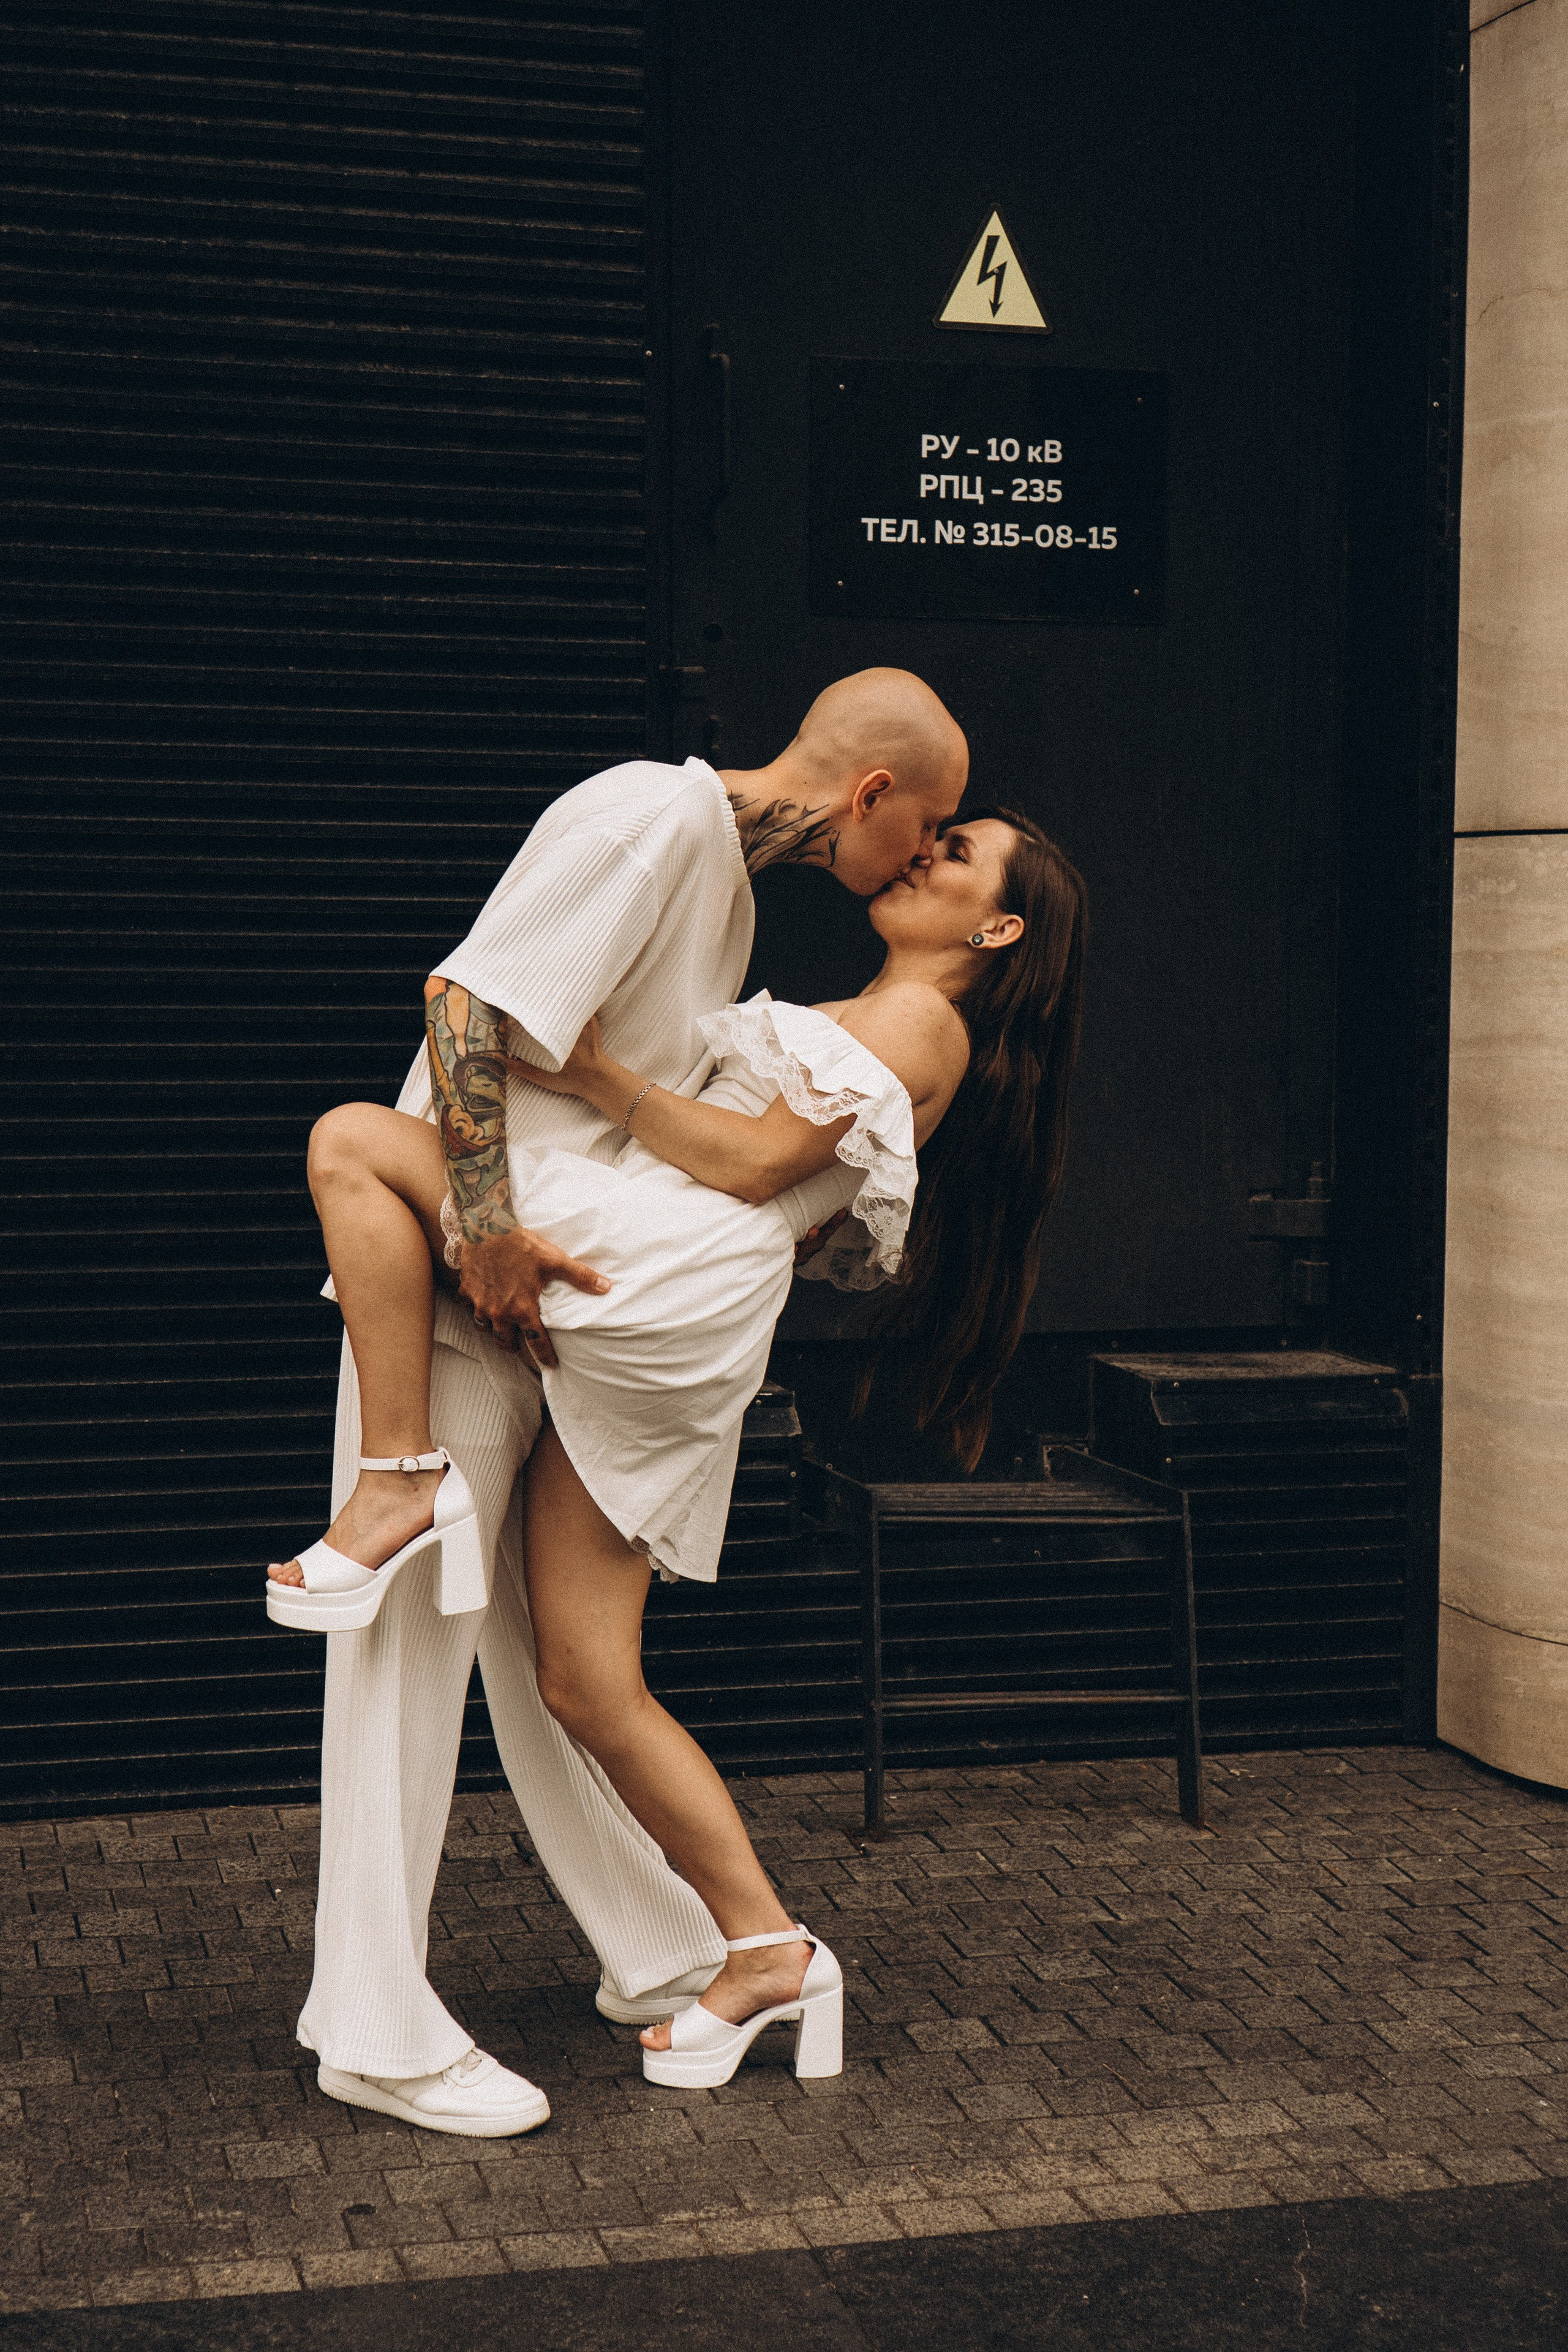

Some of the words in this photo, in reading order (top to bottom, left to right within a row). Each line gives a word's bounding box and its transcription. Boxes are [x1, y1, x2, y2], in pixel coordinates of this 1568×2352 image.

[920, 434, 960, 459] РУ
[987, 437, 1020, 462] 10
[1028, 439, 1063, 463] кВ
[919, 473, 984, 505] РПЦ
[1011, 478, 1063, 503] 235
[861, 517, 927, 544] ТЕЛ.
[935, 519, 966, 545] №
[973, 521, 1118, 550] 315-08-15
